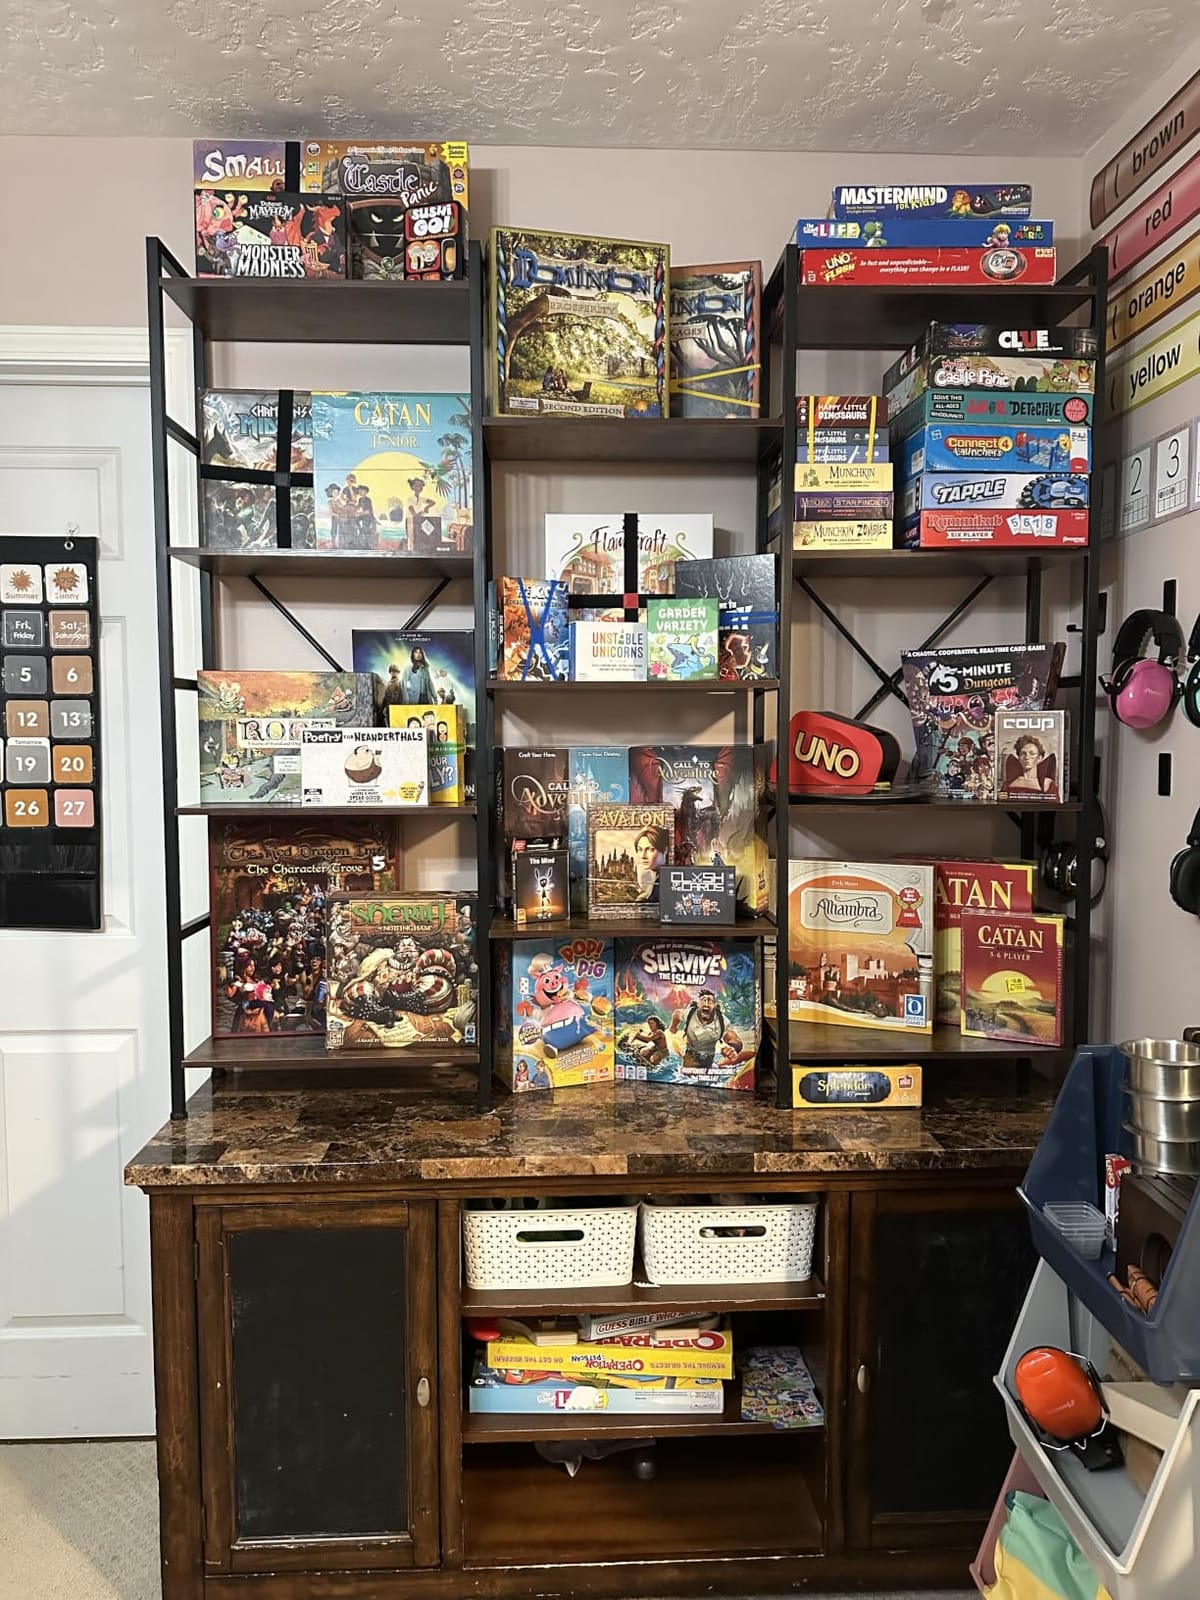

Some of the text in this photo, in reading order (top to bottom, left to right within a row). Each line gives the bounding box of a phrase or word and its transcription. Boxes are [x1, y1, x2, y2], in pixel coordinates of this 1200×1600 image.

[1131, 109, 1185, 177] brown
[342, 157, 418, 193] Castle
[400, 181, 438, 208] Panic
[840, 187, 948, 205] MASTERMIND
[248, 203, 295, 221] MAYHEM
[1144, 191, 1172, 237] red
[413, 217, 450, 237] GO!
[819, 223, 859, 238] LIFE
[1014, 230, 1045, 240] MARIO
[240, 245, 302, 262] MONSTER
[825, 252, 851, 270] UNO
[235, 259, 306, 279] MADNESS
[823, 262, 856, 283] FLASH
[1128, 262, 1186, 319] orange
[550, 301, 619, 316] PROSPERITY
[998, 329, 1049, 349] CLUE
[935, 368, 1010, 388] Castle Panic
[1130, 343, 1182, 399] yellow
[250, 403, 309, 418] CHAMNS
[354, 400, 432, 427] CATAN
[543, 402, 623, 416] SECOND EDITION
[818, 411, 868, 420] DINOSAURS
[370, 434, 417, 449] JUNIOR
[1166, 438, 1180, 479] 3
[829, 466, 876, 480] MUNCHKIN
[1130, 456, 1142, 497] 2
[937, 478, 1007, 504] TAPPLE
[927, 513, 1004, 531] Rummikub
[1010, 518, 1019, 529] 5
[1022, 517, 1030, 528] 6
[1044, 517, 1054, 530] 8
[589, 523, 669, 554] Flamraft
[814, 524, 855, 538] MUNCHKIN
[6, 592, 39, 600] Summer
[55, 592, 80, 601] Sunny
[658, 607, 706, 619] GARDEN
[15, 620, 32, 630] Fri.
[656, 619, 709, 632] VARIETY
[13, 631, 36, 641] Friday
[55, 631, 88, 641] Saturday
[592, 630, 644, 645] UNSTABLE
[592, 645, 644, 659] UNICORNS
[1010, 645, 1027, 653] CARD
[20, 667, 32, 682] 5
[66, 667, 78, 682] 6
[963, 677, 1013, 690] Dungeon
[17, 712, 38, 727] 12
[61, 712, 81, 727] 13
[303, 731, 342, 743] Poetry
[354, 731, 424, 742] NEANDERTHALS
[430, 756, 448, 767] OUR
[794, 731, 860, 778] UNO
[16, 757, 37, 772] 19
[61, 757, 84, 772] 20
[547, 782, 575, 791] CALL
[15, 801, 40, 816] 26
[63, 801, 86, 816] 27
[598, 810, 667, 828] AVALON
[246, 861, 364, 876] The Character Trove
[371, 855, 386, 871] 5
[934, 877, 1014, 911] ATAN
[810, 896, 883, 923] Alhambra
[977, 925, 1044, 949] CATAN
[559, 937, 605, 963] POP!
[1003, 952, 1031, 961] PLAYER
[641, 948, 722, 976] SURVIVE
[659, 972, 706, 985] THE ISLAND
[817, 1079, 874, 1097] Splendor
[597, 1319, 628, 1334] GUESS
[628, 1314, 656, 1327] BIBLE
[585, 1359, 644, 1371] OPERATION
